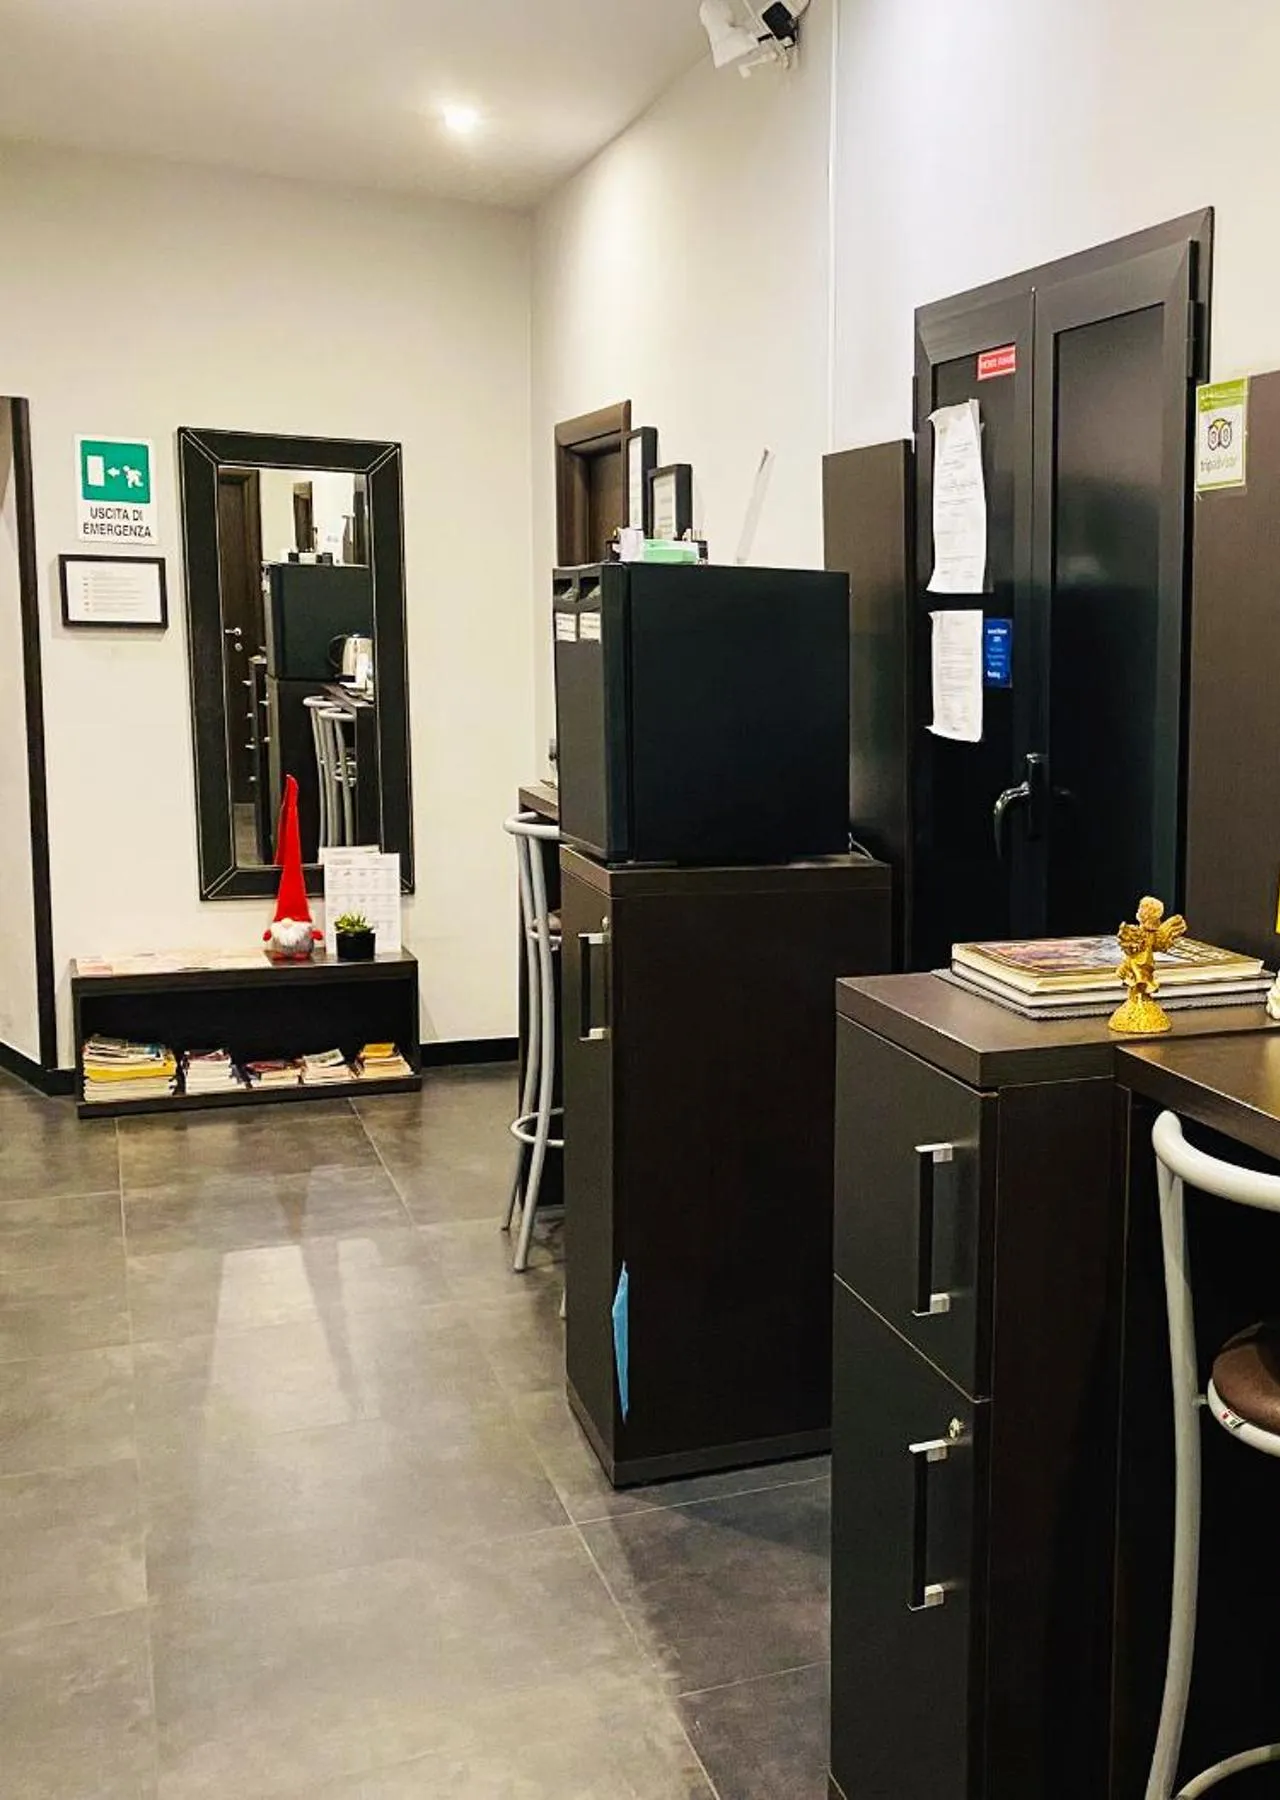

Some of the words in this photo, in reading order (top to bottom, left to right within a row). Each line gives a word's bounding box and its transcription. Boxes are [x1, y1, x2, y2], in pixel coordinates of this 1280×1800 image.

[90, 507, 130, 521] USCITA
[132, 509, 144, 521] DI
[83, 522, 153, 538] EMERGENZA
